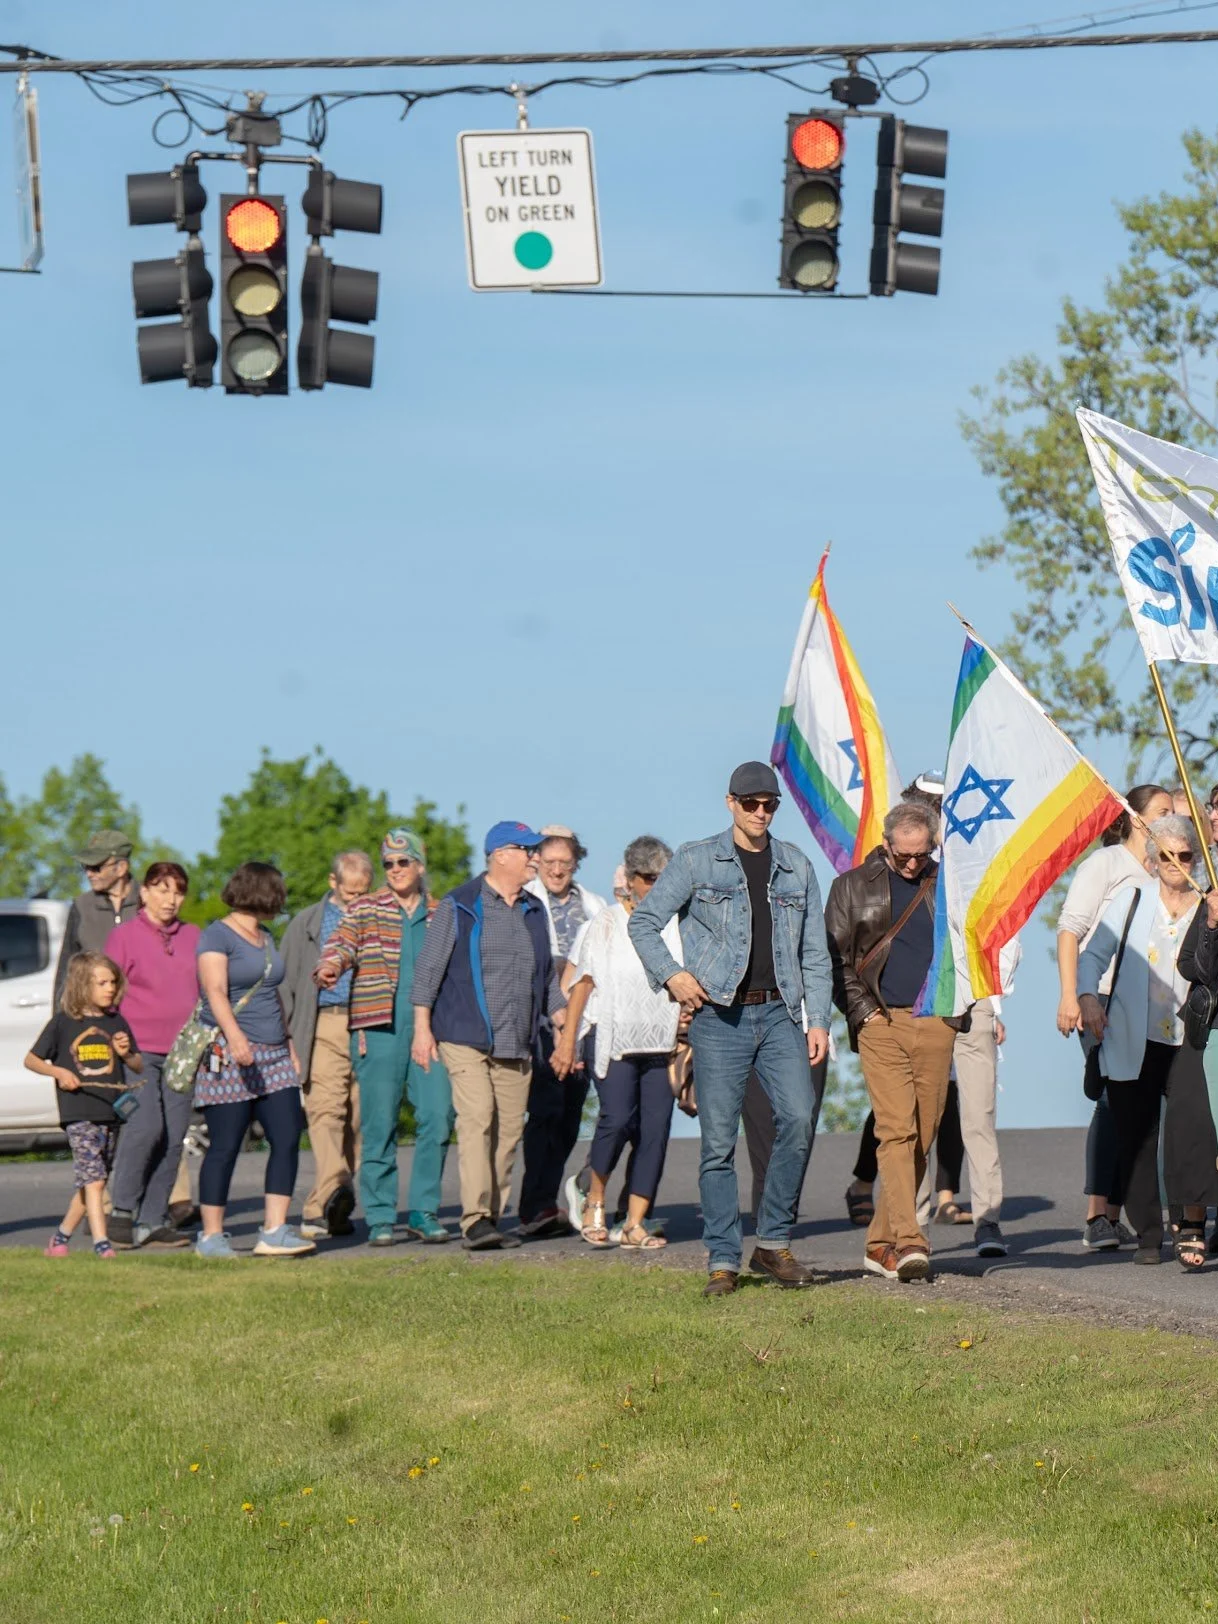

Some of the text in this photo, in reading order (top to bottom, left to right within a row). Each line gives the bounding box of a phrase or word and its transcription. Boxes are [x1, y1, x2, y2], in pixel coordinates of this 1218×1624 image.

[478, 150, 573, 168] LEFT TURN
[494, 175, 562, 197] YIELD
[485, 204, 576, 223] ON GREEN
